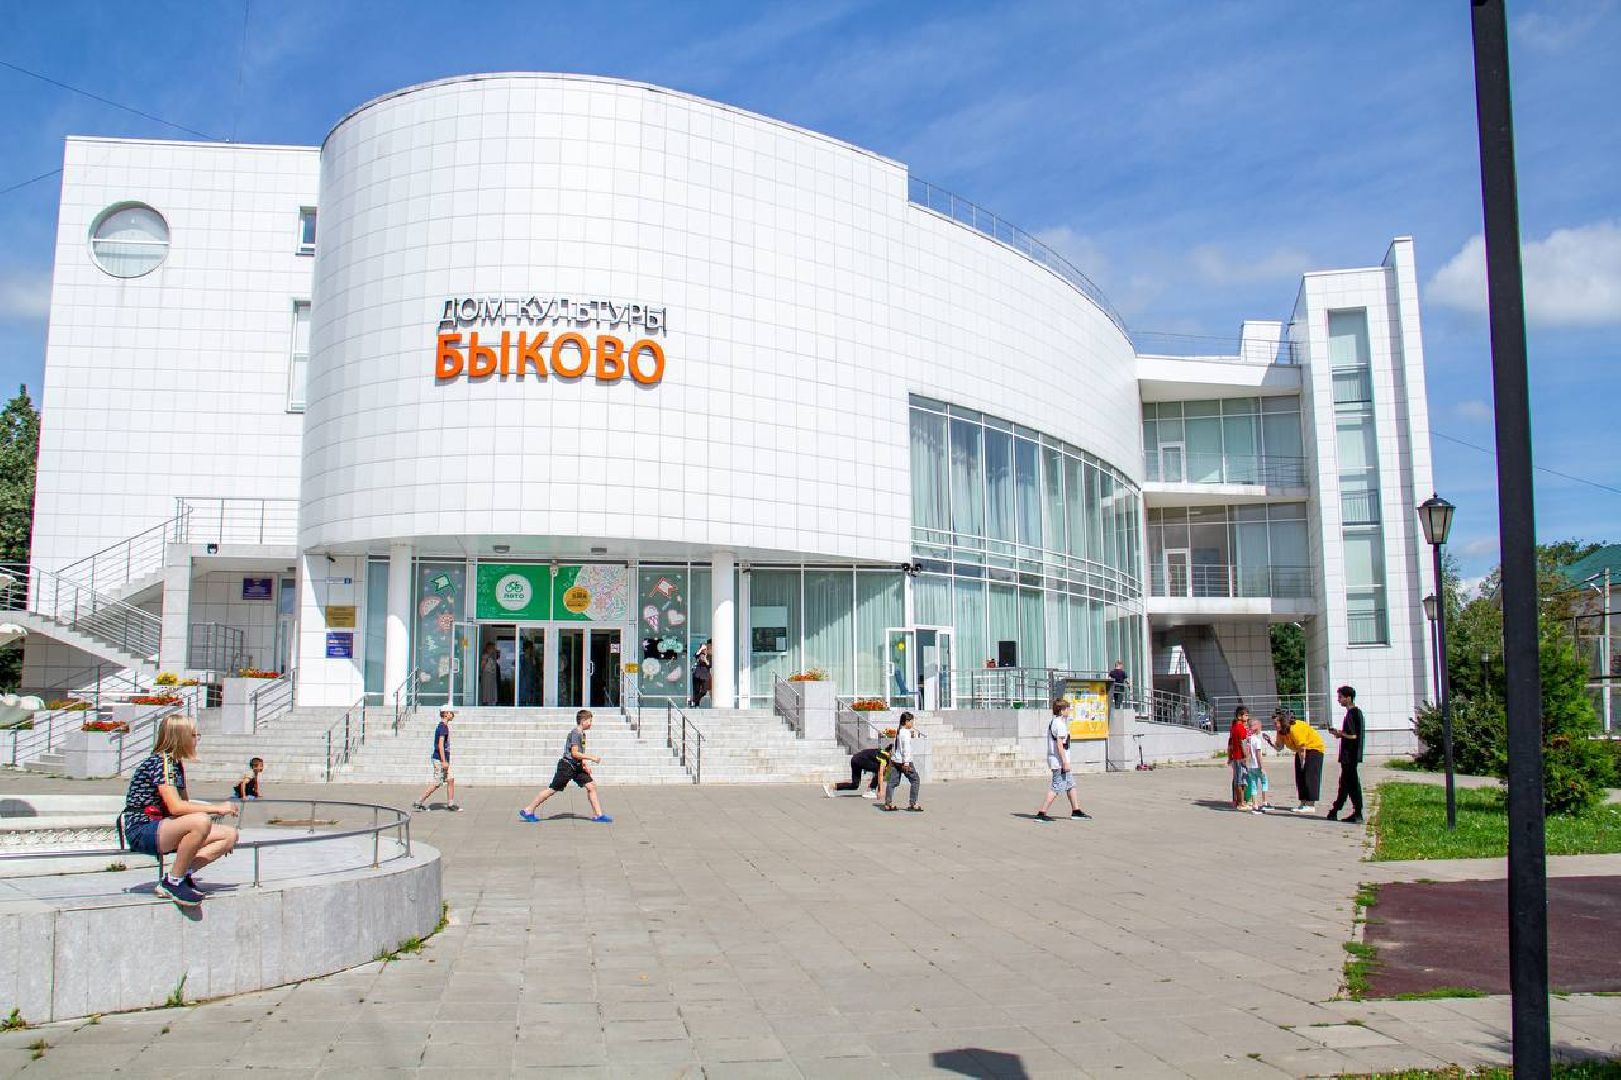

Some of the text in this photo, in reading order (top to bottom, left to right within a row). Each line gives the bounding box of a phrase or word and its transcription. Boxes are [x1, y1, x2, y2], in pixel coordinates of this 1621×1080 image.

[440, 296, 667, 331] ДОМ КУЛЬТУРЫ
[435, 330, 665, 384] БЫКОВО
